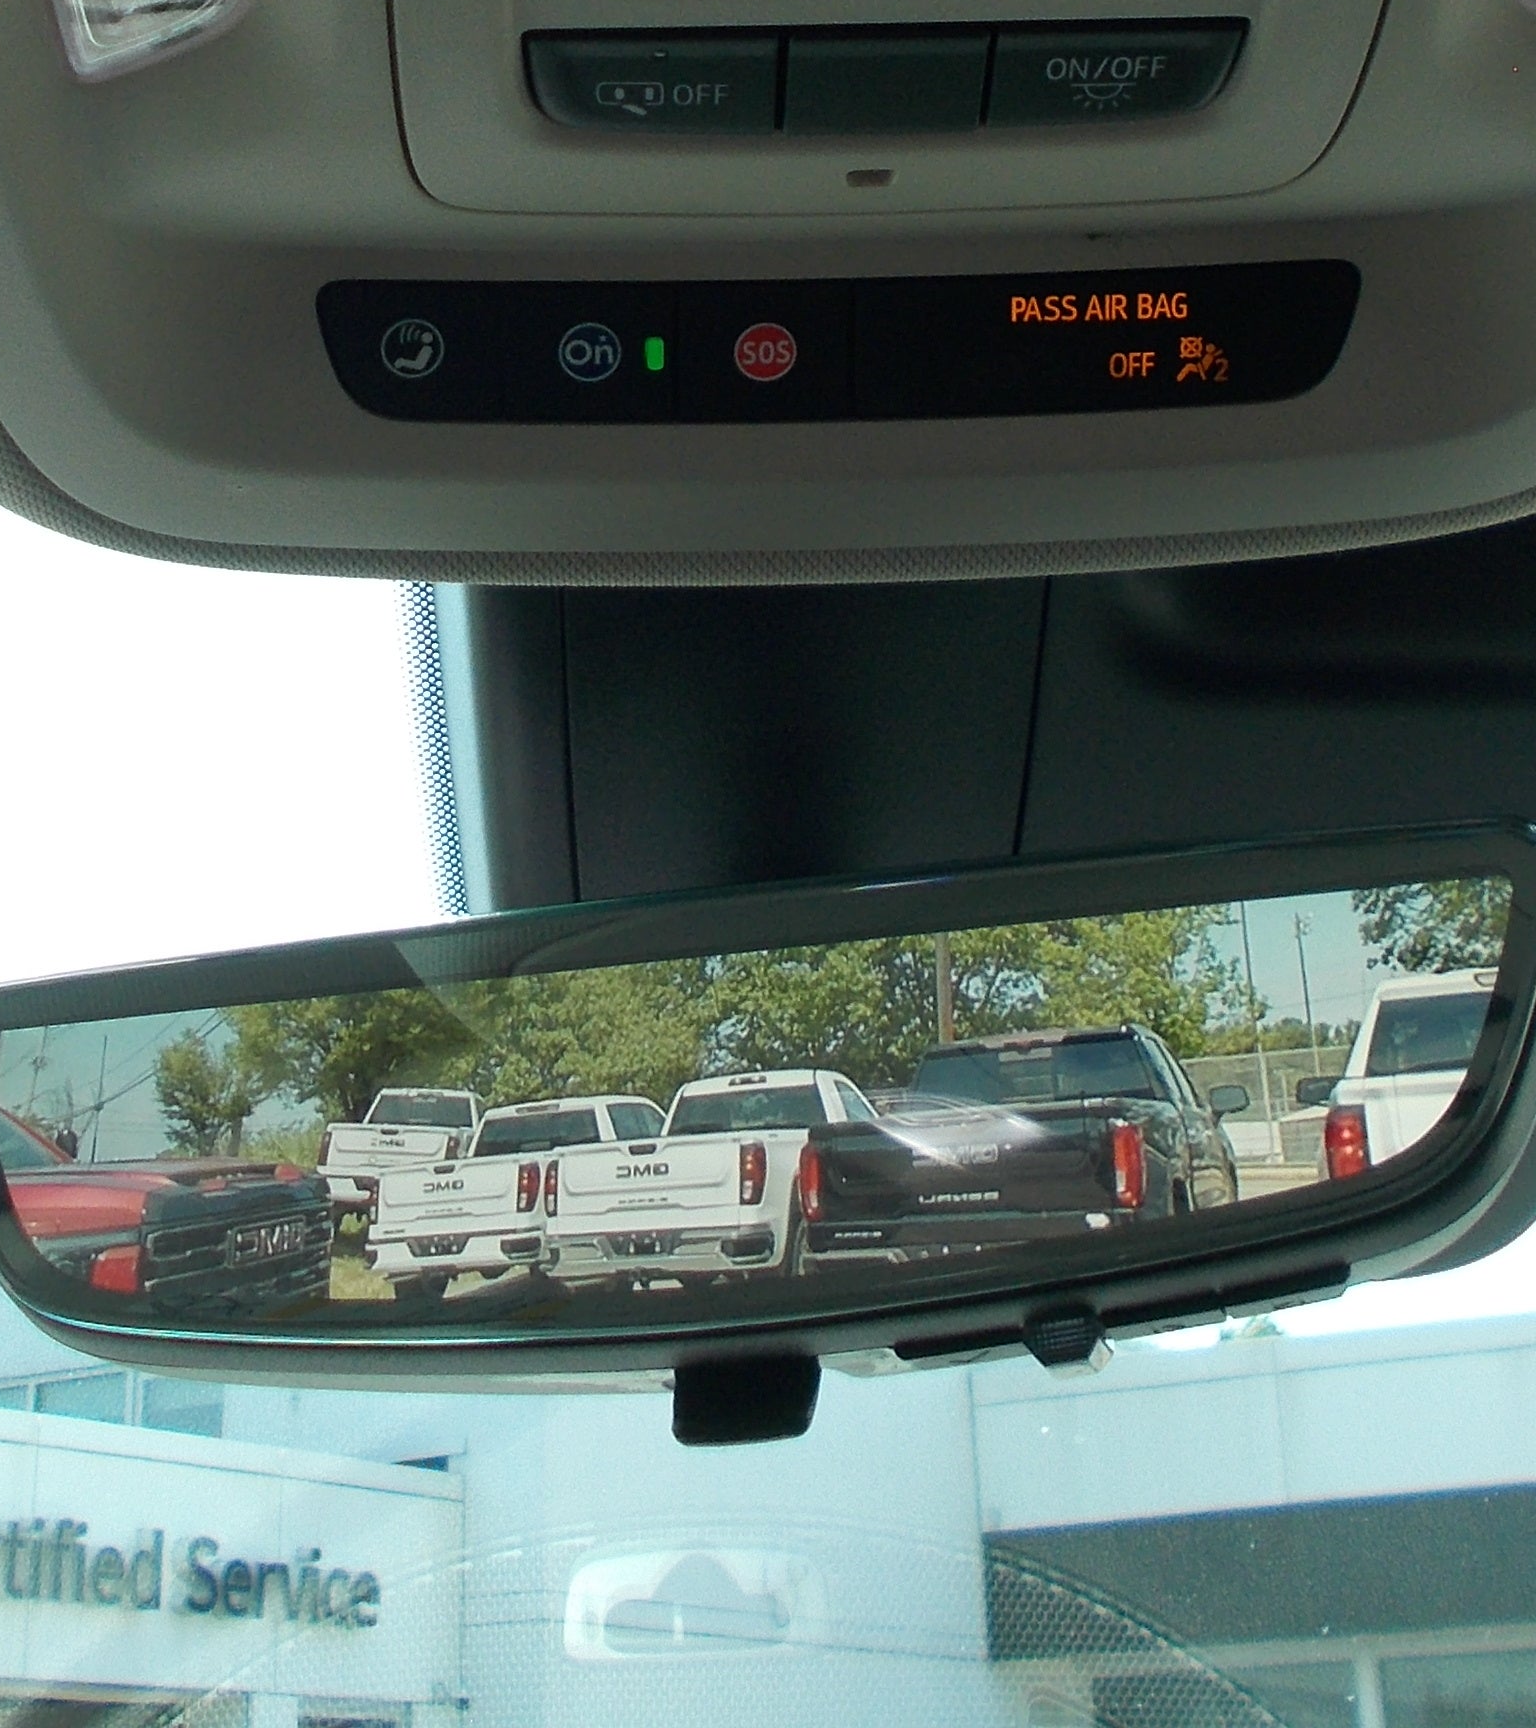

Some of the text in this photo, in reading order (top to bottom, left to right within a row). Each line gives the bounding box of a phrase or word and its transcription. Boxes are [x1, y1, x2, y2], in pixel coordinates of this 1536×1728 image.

[1046, 56, 1167, 80] ON/OFF
[672, 83, 729, 106] OFF
[1010, 292, 1188, 322] PASS AIR BAG
[743, 340, 791, 365] SOS
[1109, 352, 1156, 379] OFF
[175, 1536, 382, 1630] Service
